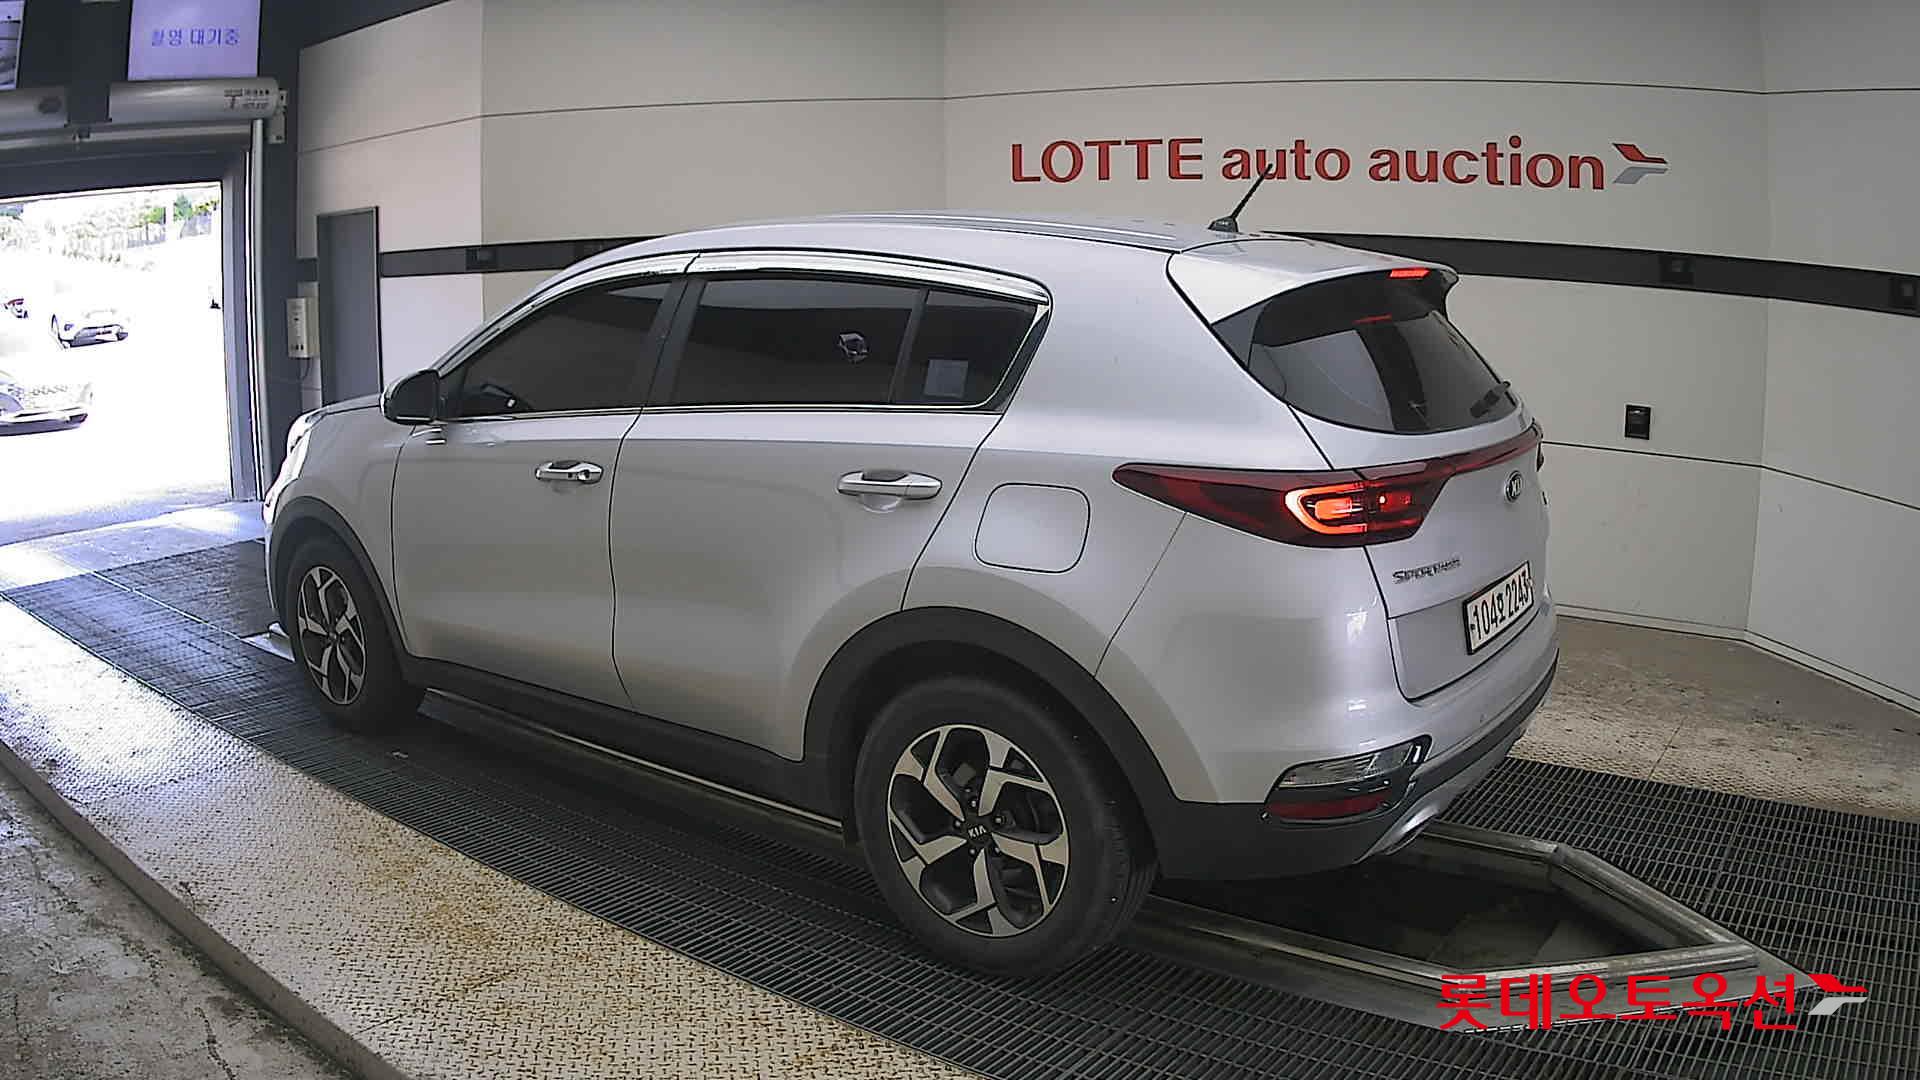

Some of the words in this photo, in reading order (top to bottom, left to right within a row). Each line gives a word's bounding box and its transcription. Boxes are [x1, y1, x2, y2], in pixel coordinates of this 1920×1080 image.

[1011, 138, 1203, 183] LOTTE
[1220, 139, 1350, 181] auto
[1367, 135, 1605, 190] auction
[1505, 570, 1529, 618] 2243
[967, 825, 987, 838] KIA
